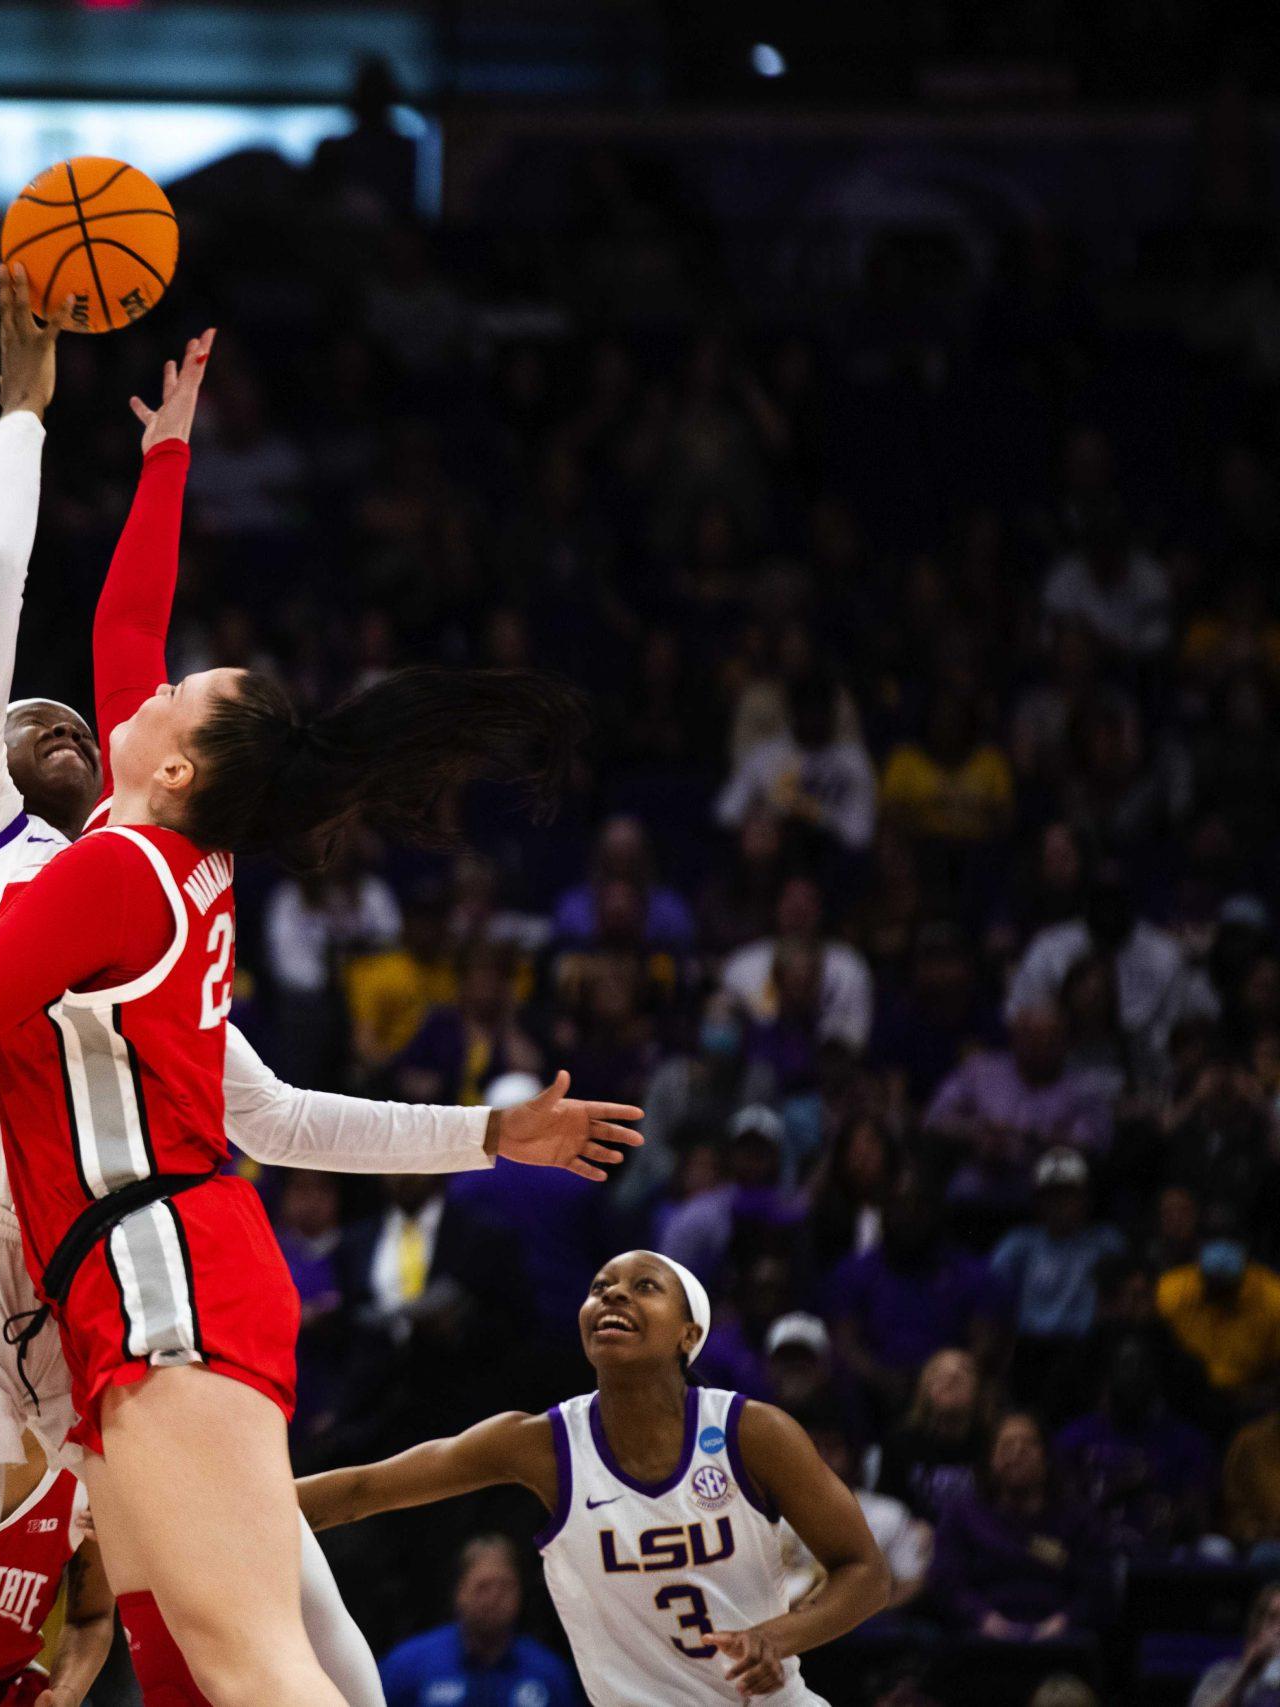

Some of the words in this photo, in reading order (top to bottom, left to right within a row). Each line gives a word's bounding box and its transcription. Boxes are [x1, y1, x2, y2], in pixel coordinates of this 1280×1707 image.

[694, 1466, 728, 1499] SEC
[598, 1516, 736, 1573] LSU
[654, 1583, 719, 1659] 3
